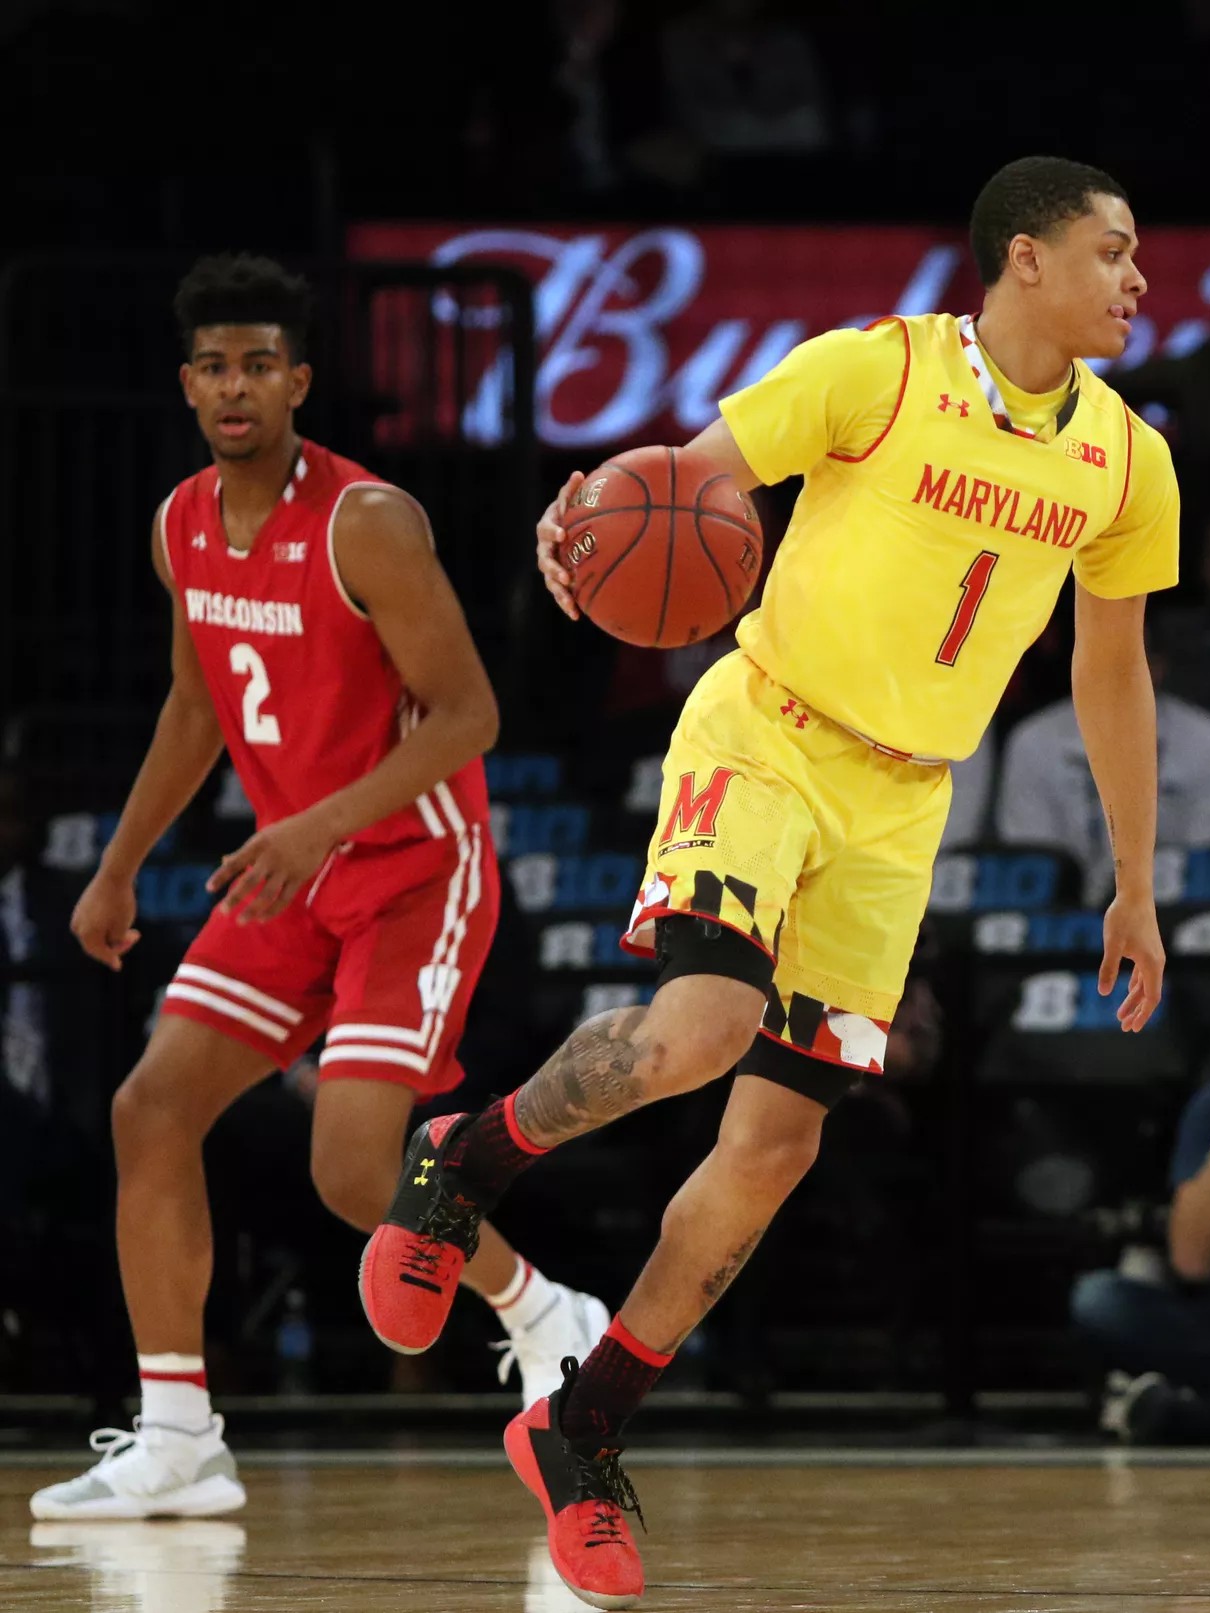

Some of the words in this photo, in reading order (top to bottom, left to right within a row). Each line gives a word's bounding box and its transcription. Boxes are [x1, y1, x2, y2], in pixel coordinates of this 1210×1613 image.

[911, 463, 1089, 549] MARYLAND
[185, 588, 304, 636] WISCONSIN
[935, 549, 1000, 667] 1
[229, 642, 281, 745] 2
